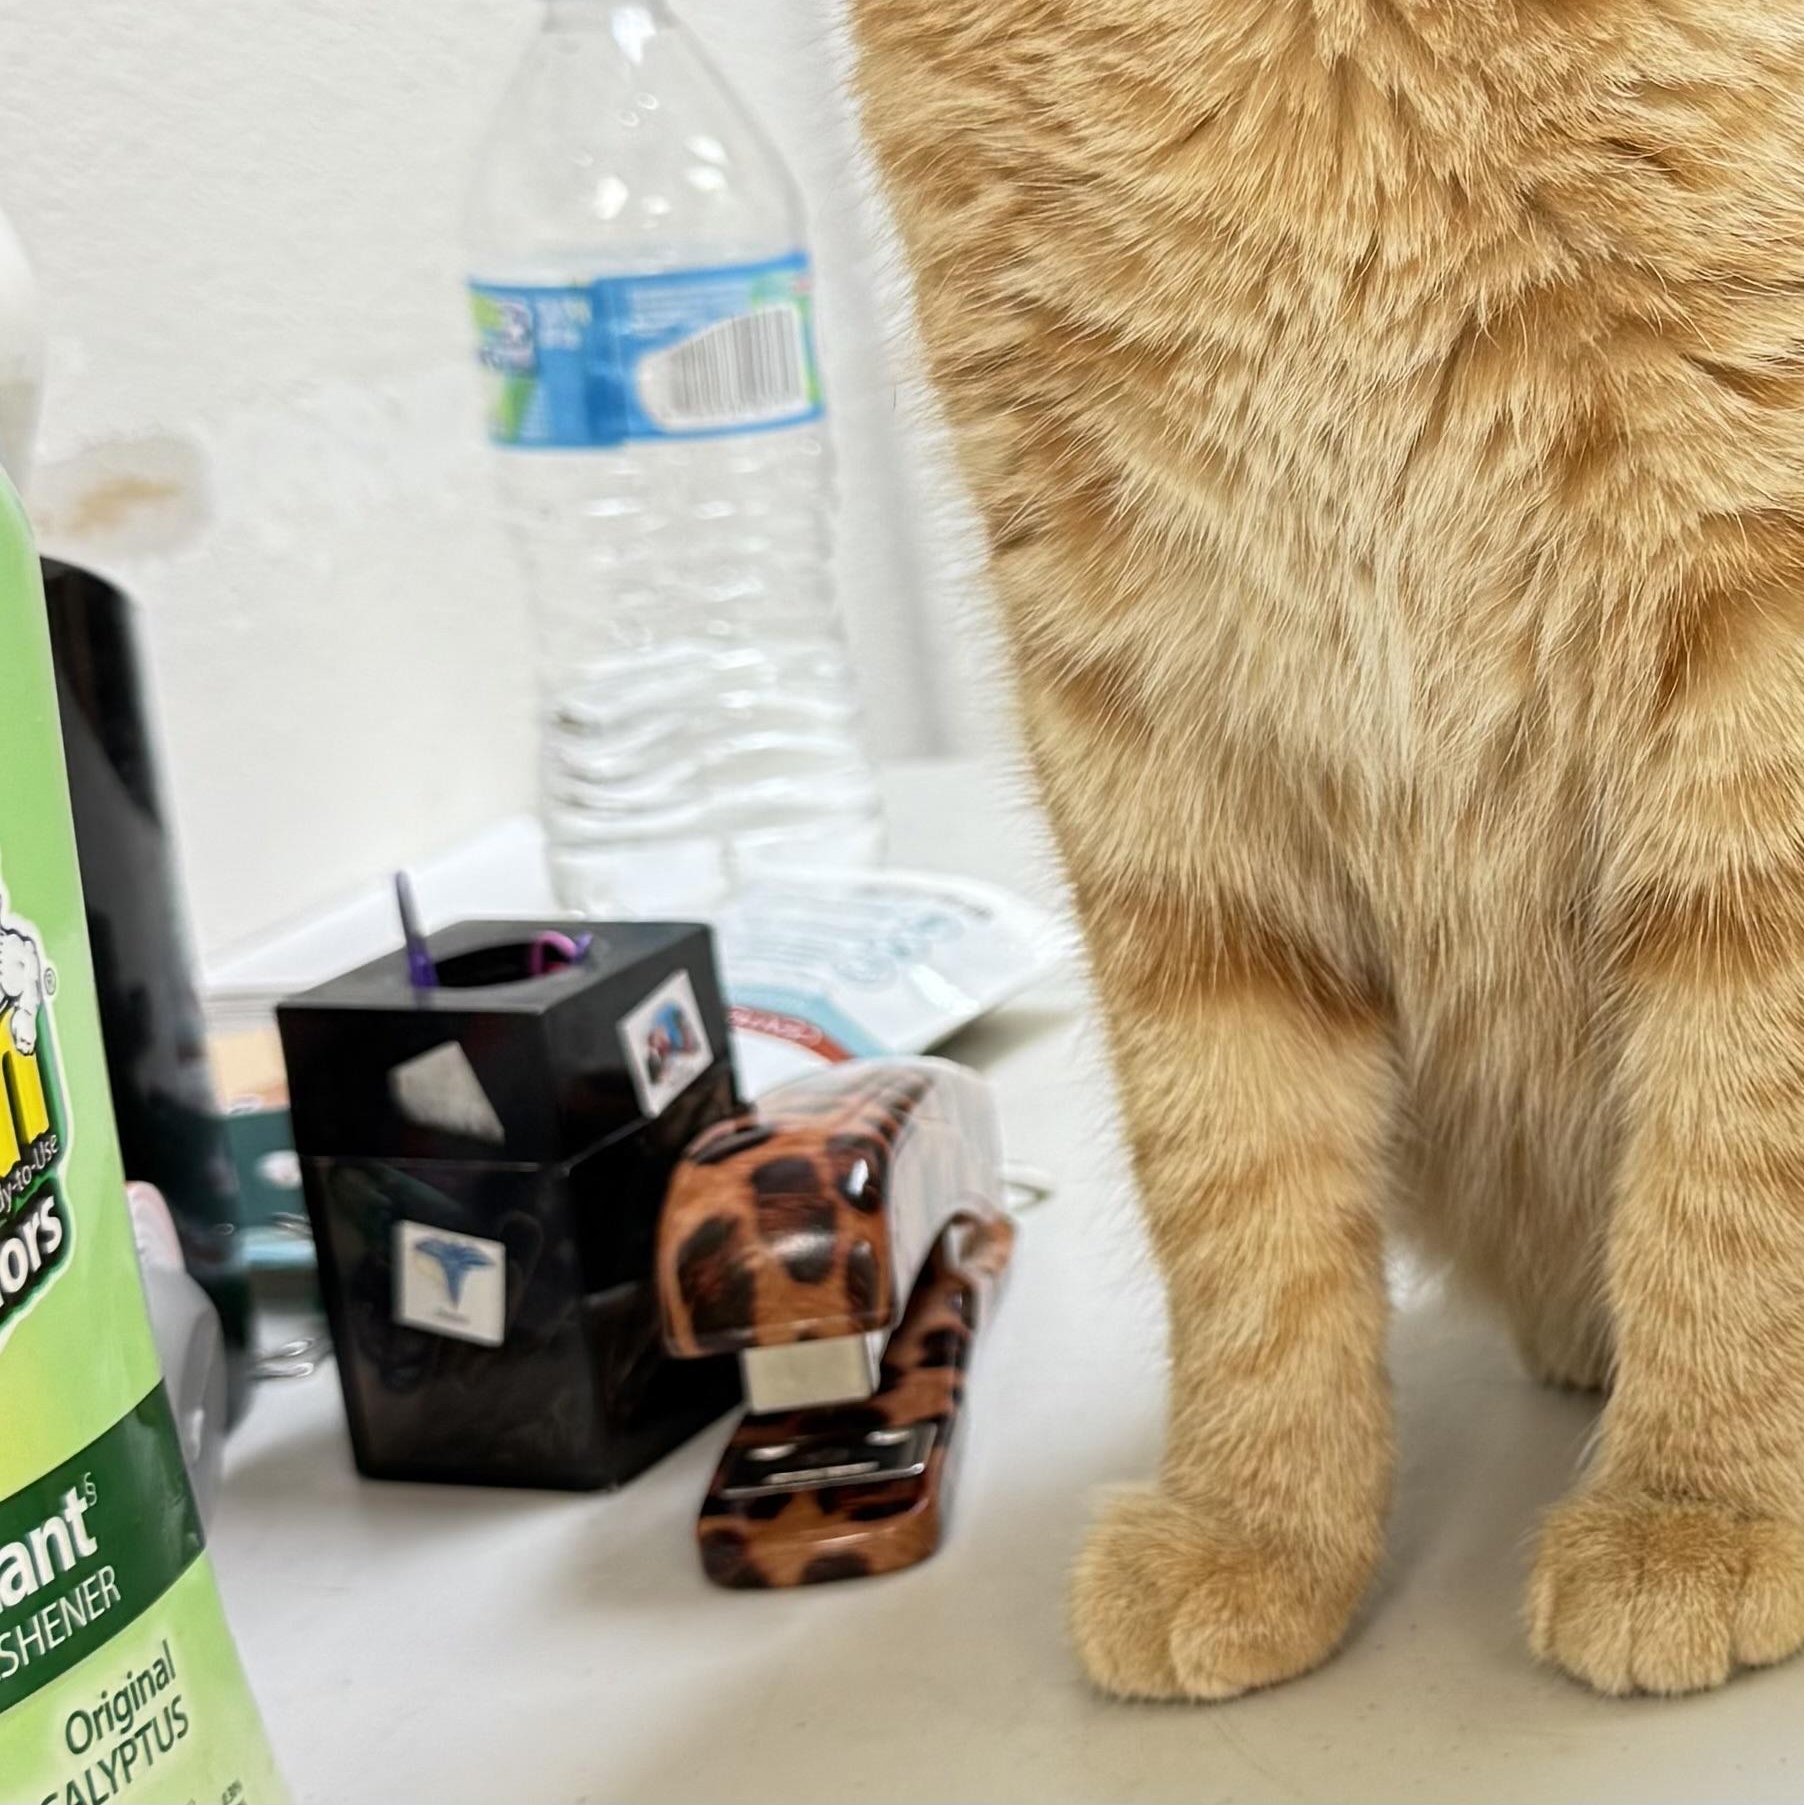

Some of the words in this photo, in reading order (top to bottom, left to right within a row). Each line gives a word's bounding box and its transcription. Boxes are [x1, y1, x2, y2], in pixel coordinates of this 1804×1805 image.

[0, 1195, 63, 1308] ors
[0, 1565, 121, 1680] SHENER
[65, 1639, 176, 1754] Original
